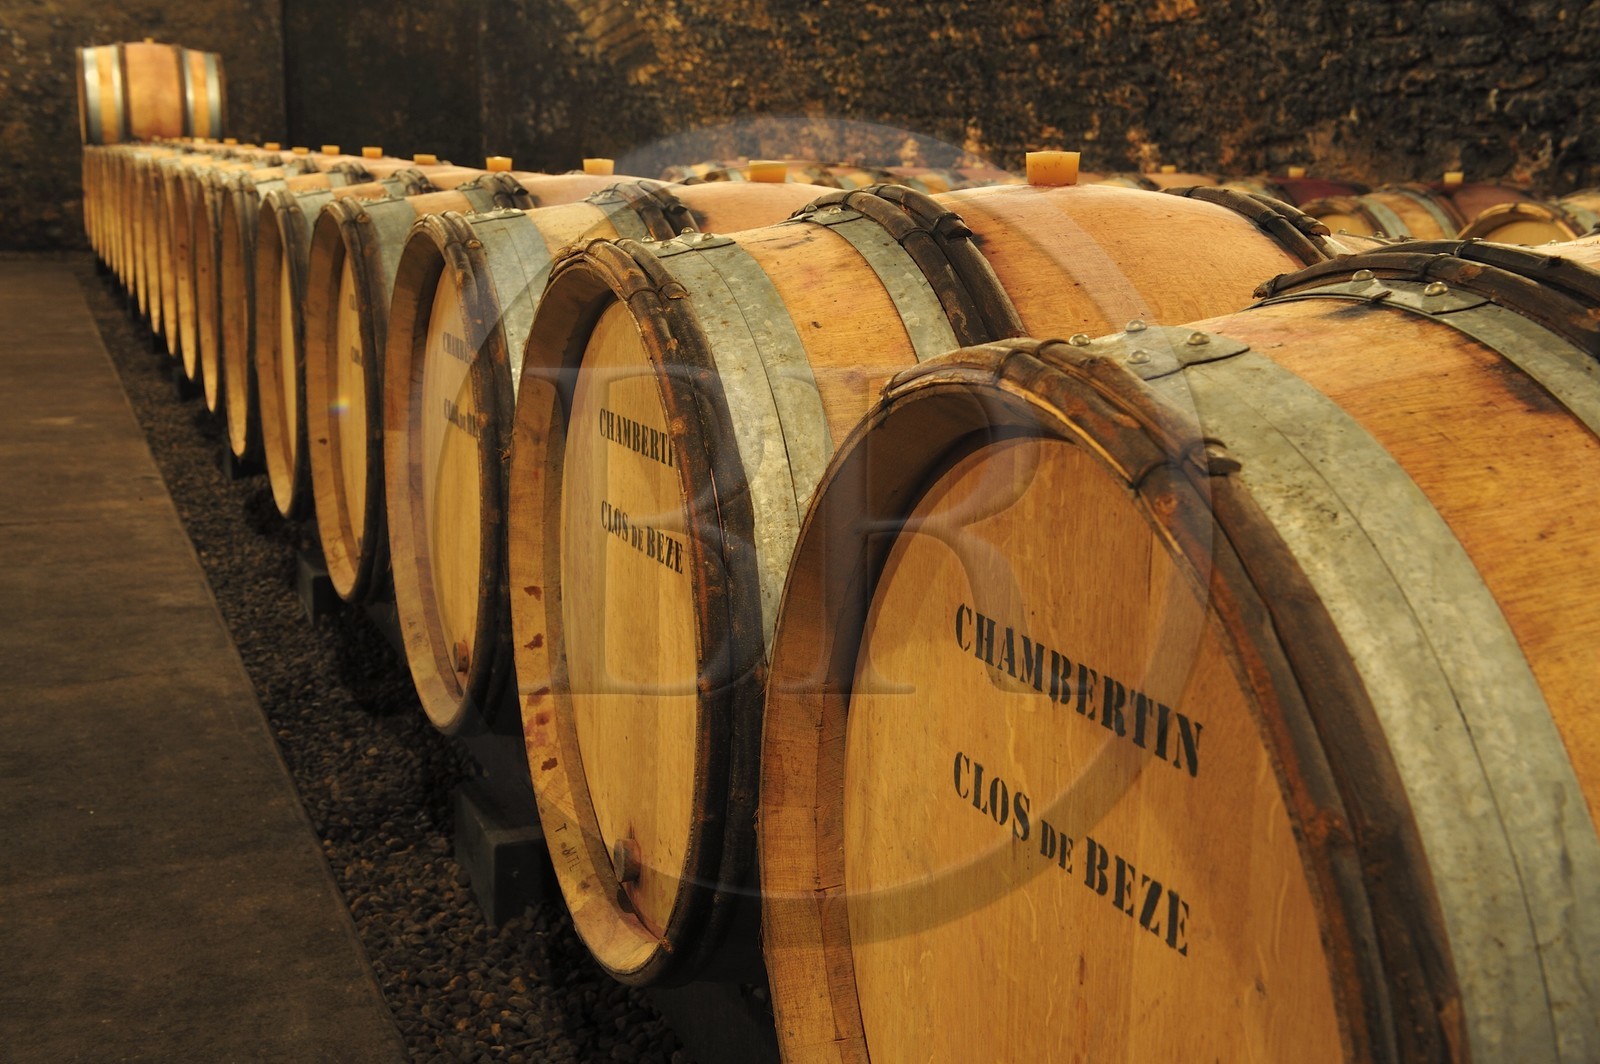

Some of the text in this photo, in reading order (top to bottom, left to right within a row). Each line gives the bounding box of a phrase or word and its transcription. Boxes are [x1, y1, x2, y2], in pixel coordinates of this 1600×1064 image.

[599, 407, 674, 468] CHAMBERTI
[601, 500, 683, 575] CLOS DE BEZE
[955, 603, 1203, 778] CHAMBERTIN
[953, 751, 1189, 957] CLOS DE BEZE
